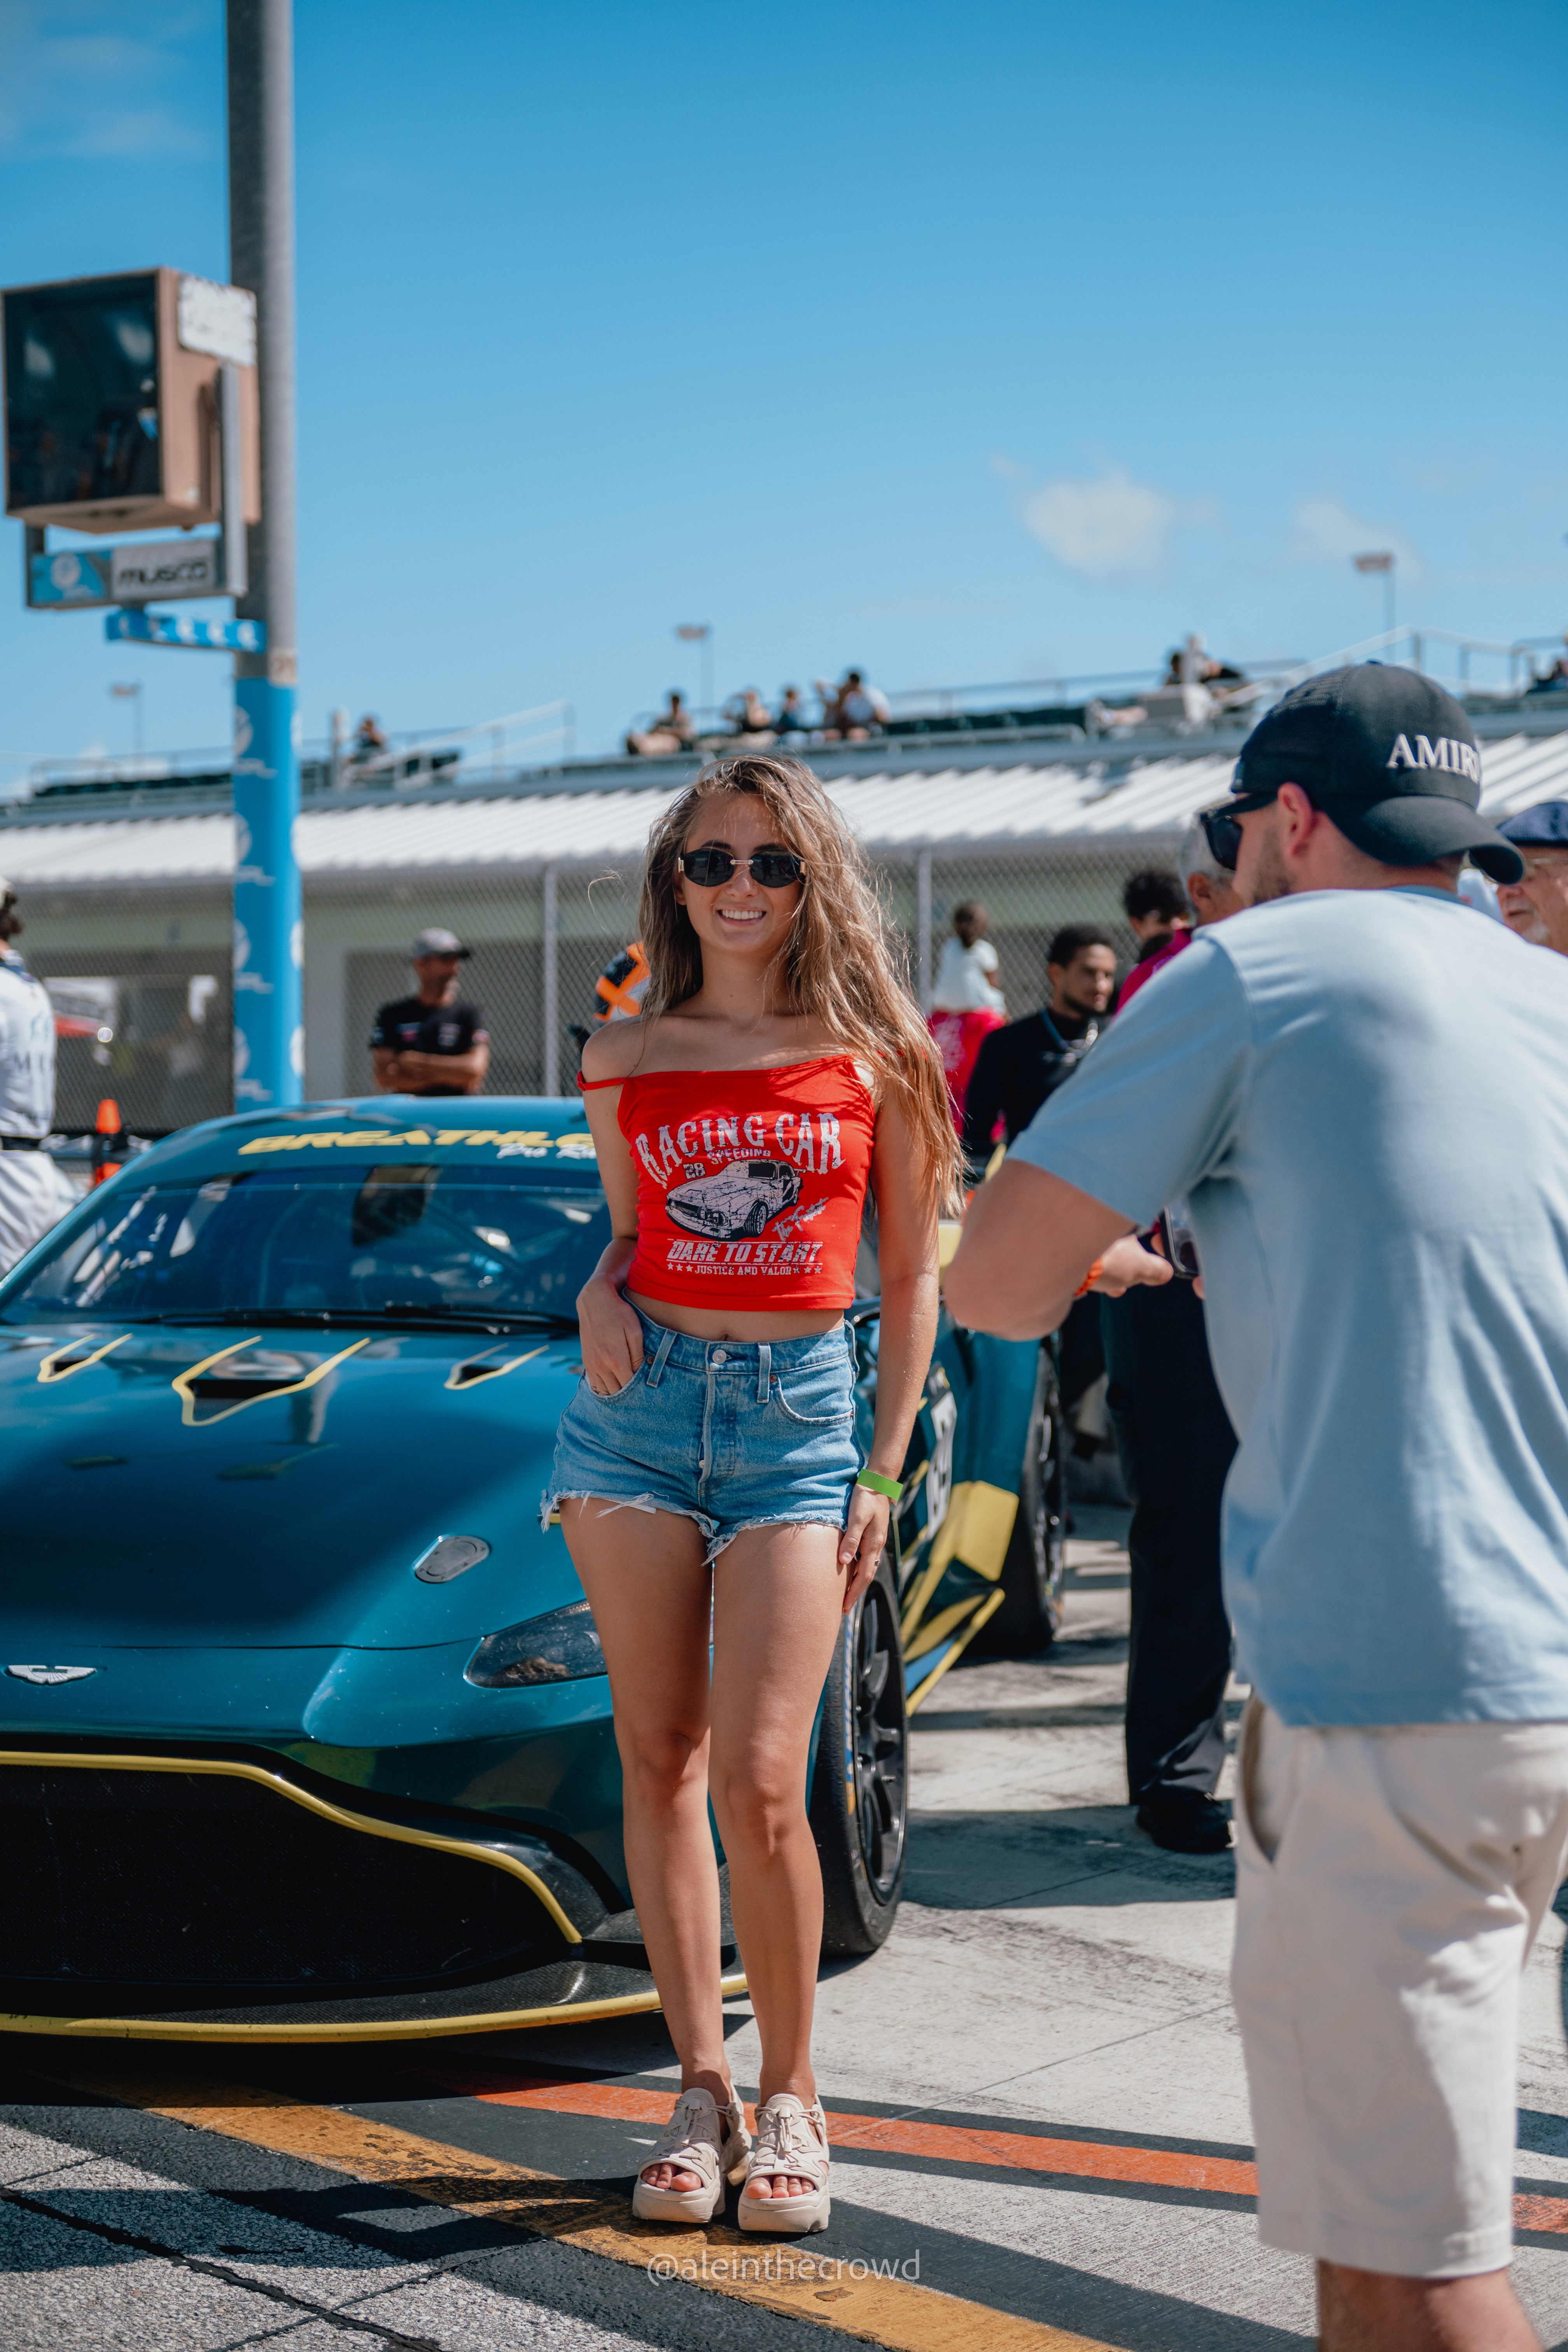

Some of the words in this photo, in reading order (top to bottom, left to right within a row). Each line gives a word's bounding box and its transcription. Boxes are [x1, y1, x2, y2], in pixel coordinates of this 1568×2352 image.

[119, 560, 208, 584] musco
[496, 1143, 548, 1160] Pro
[635, 1115, 767, 1190] RACING
[774, 1112, 846, 1174] CAR
[707, 1148, 772, 1165] SPEEDING
[683, 1162, 706, 1180] 28
[667, 1241, 721, 1262] DARE
[724, 1244, 752, 1262] TO
[753, 1244, 823, 1262] START
[695, 1265, 735, 1275] JUSTICE
[737, 1266, 758, 1276] AND
[761, 1266, 792, 1276] VALOR
